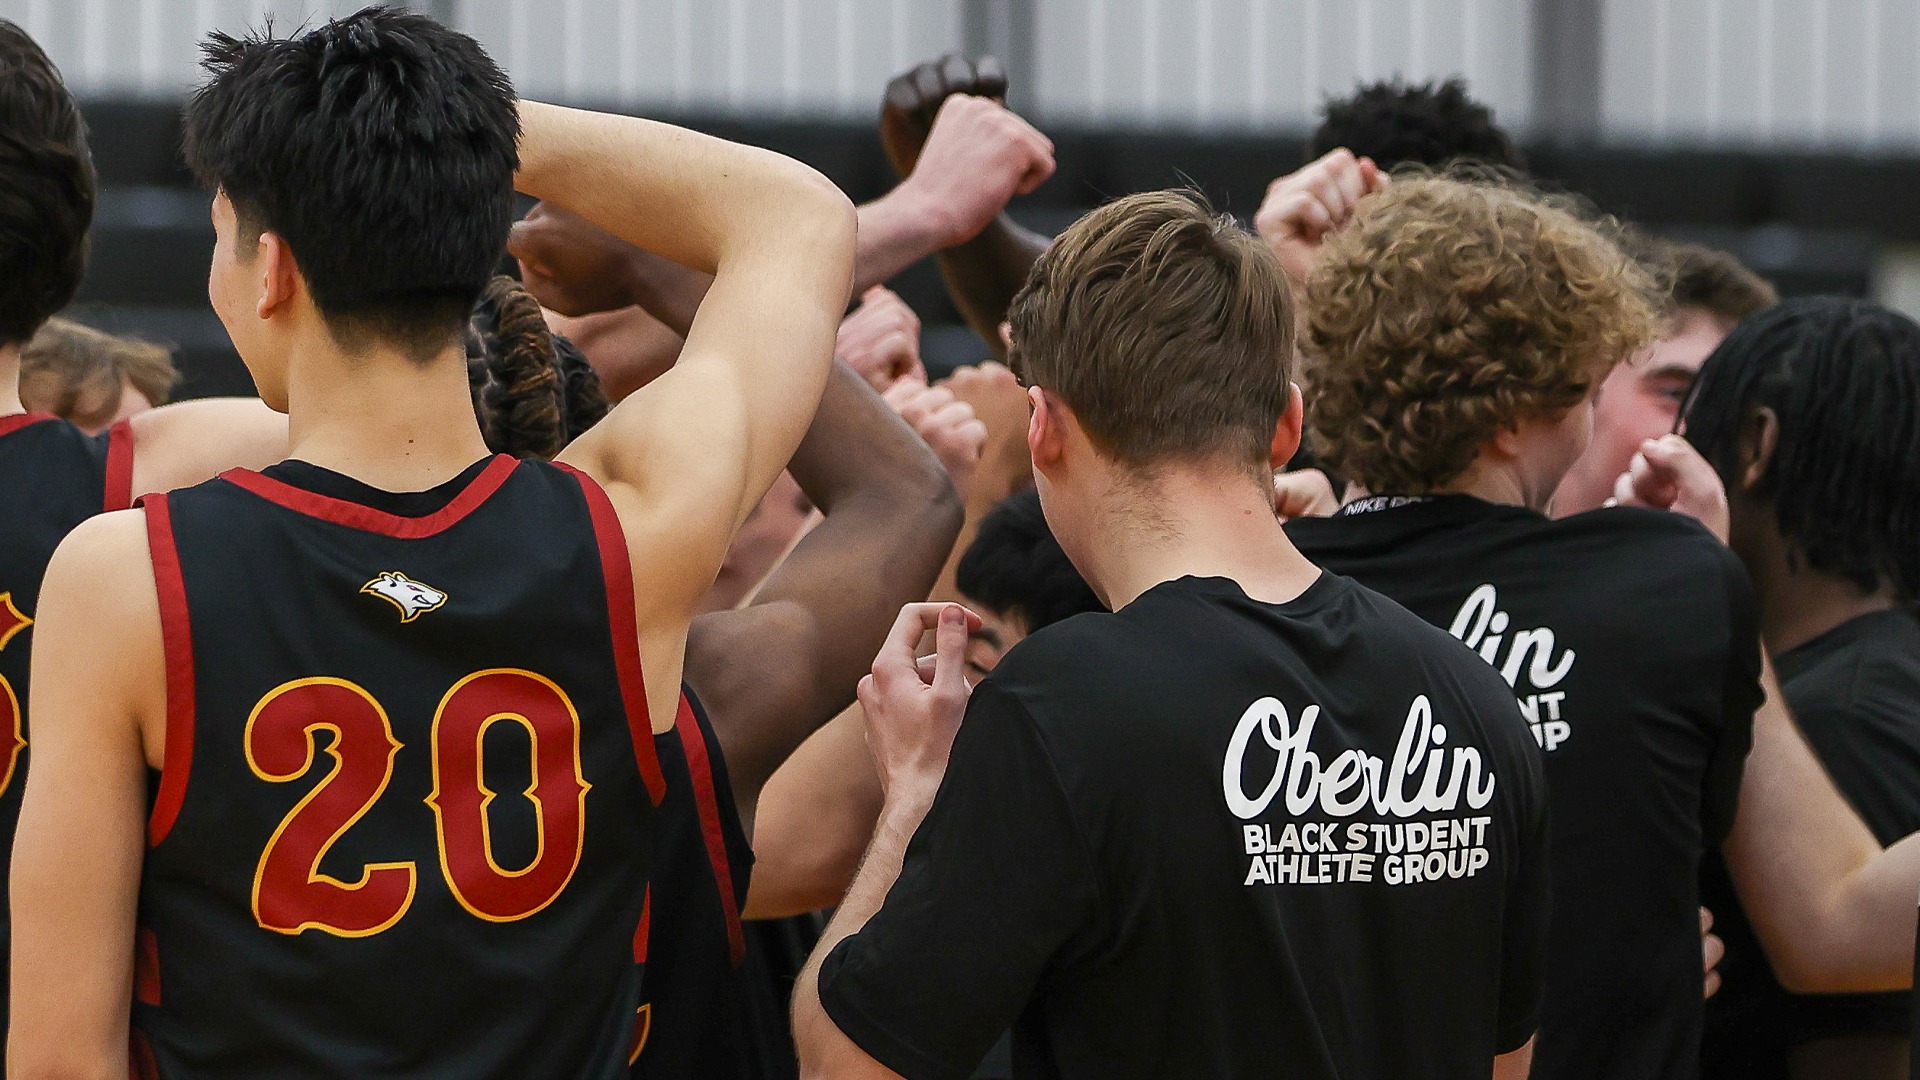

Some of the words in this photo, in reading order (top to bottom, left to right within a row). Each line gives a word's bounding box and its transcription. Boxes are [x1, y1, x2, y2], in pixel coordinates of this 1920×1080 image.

[1344, 496, 1389, 517] NIKE
[1222, 694, 1496, 820] Oberlin
[244, 667, 592, 938] 20
[1242, 822, 1340, 855] BLACK
[1344, 816, 1492, 853] STUDENT
[1243, 852, 1377, 886] ATHLETE
[1383, 847, 1490, 885] GROUP
